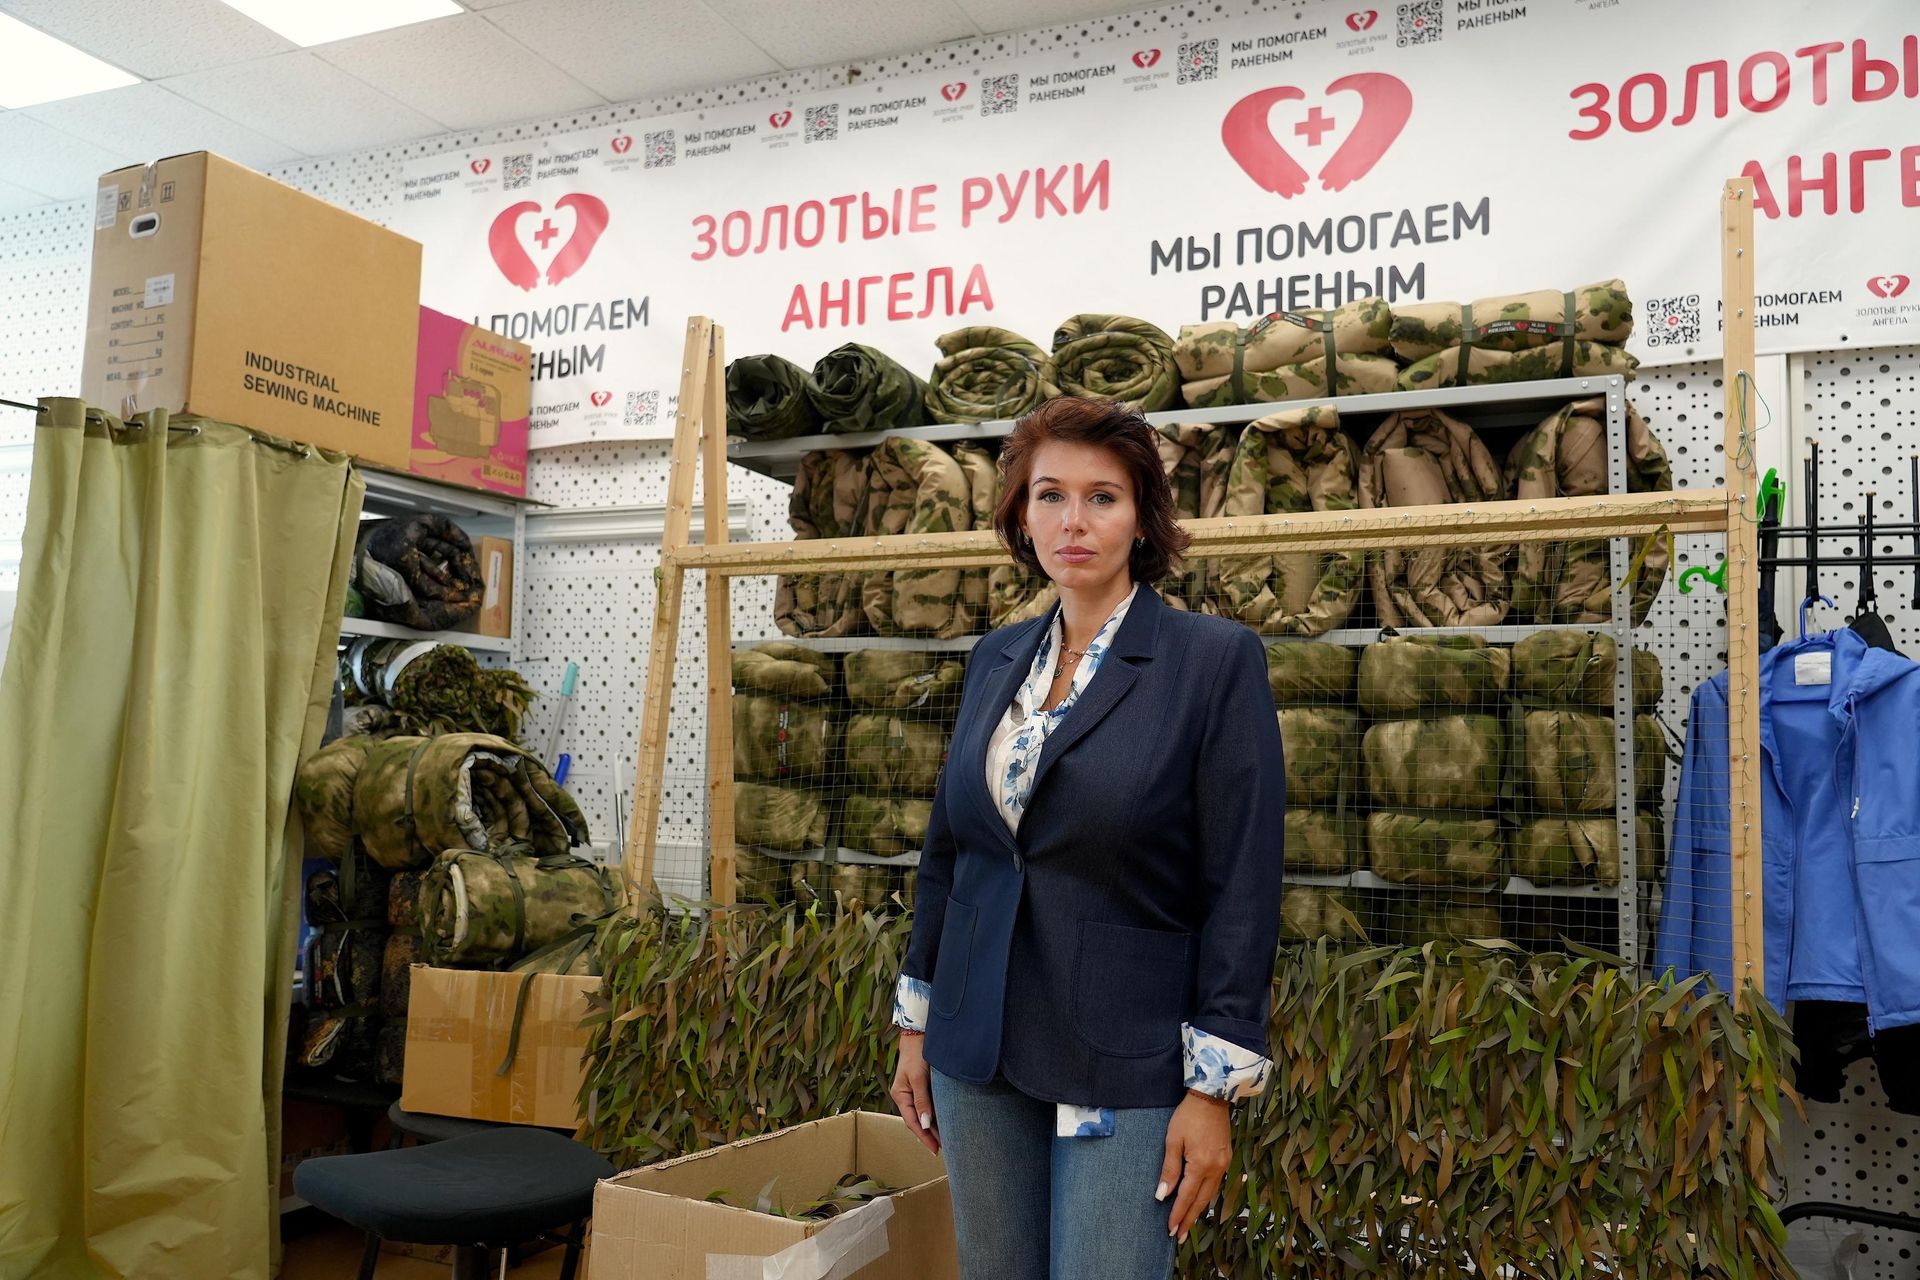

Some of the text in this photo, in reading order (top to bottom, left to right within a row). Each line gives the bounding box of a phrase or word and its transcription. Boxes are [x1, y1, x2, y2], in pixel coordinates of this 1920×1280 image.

[1457, 7, 1526, 30] РАНЕНЫМ
[1231, 27, 1327, 53] МЫ ПОМОГАЕМ
[1231, 50, 1293, 70] РАНЕНЫМ
[1030, 65, 1116, 88] МЫ ПОМОГАЕМ
[1568, 34, 1919, 141] ЗОЛОТЫ
[1029, 85, 1085, 103] РАНЕНЫМ
[848, 105, 866, 117] МЫ
[870, 97, 927, 115] ПОМОГАЕМ
[684, 133, 701, 144] МЫ
[704, 124, 756, 141] ПОМОГАЕМ
[847, 115, 898, 132] РАНЕНЫМ
[685, 143, 731, 159] РАНЕНЫМ
[691, 159, 1110, 262] ЗОЛОТЫЕ РУКИ
[1150, 196, 1491, 275] МЫ ПОМОГАЕМ
[781, 263, 995, 332] АНГЕЛА
[1200, 261, 1425, 322] РАНЕНЫМ
[1753, 290, 1842, 308] ПОМОГАЕМ
[491, 295, 650, 341] ПОМОГАЕМ
[1855, 305, 1896, 317] ЗОЛОТЫЕ
[1872, 316, 1908, 326] АНГЕЛА
[245, 351, 340, 393] INDUSTRIAL
[243, 374, 381, 427] SEWING MACHINE
[536, 401, 580, 415] ПОМОГАЕМ
